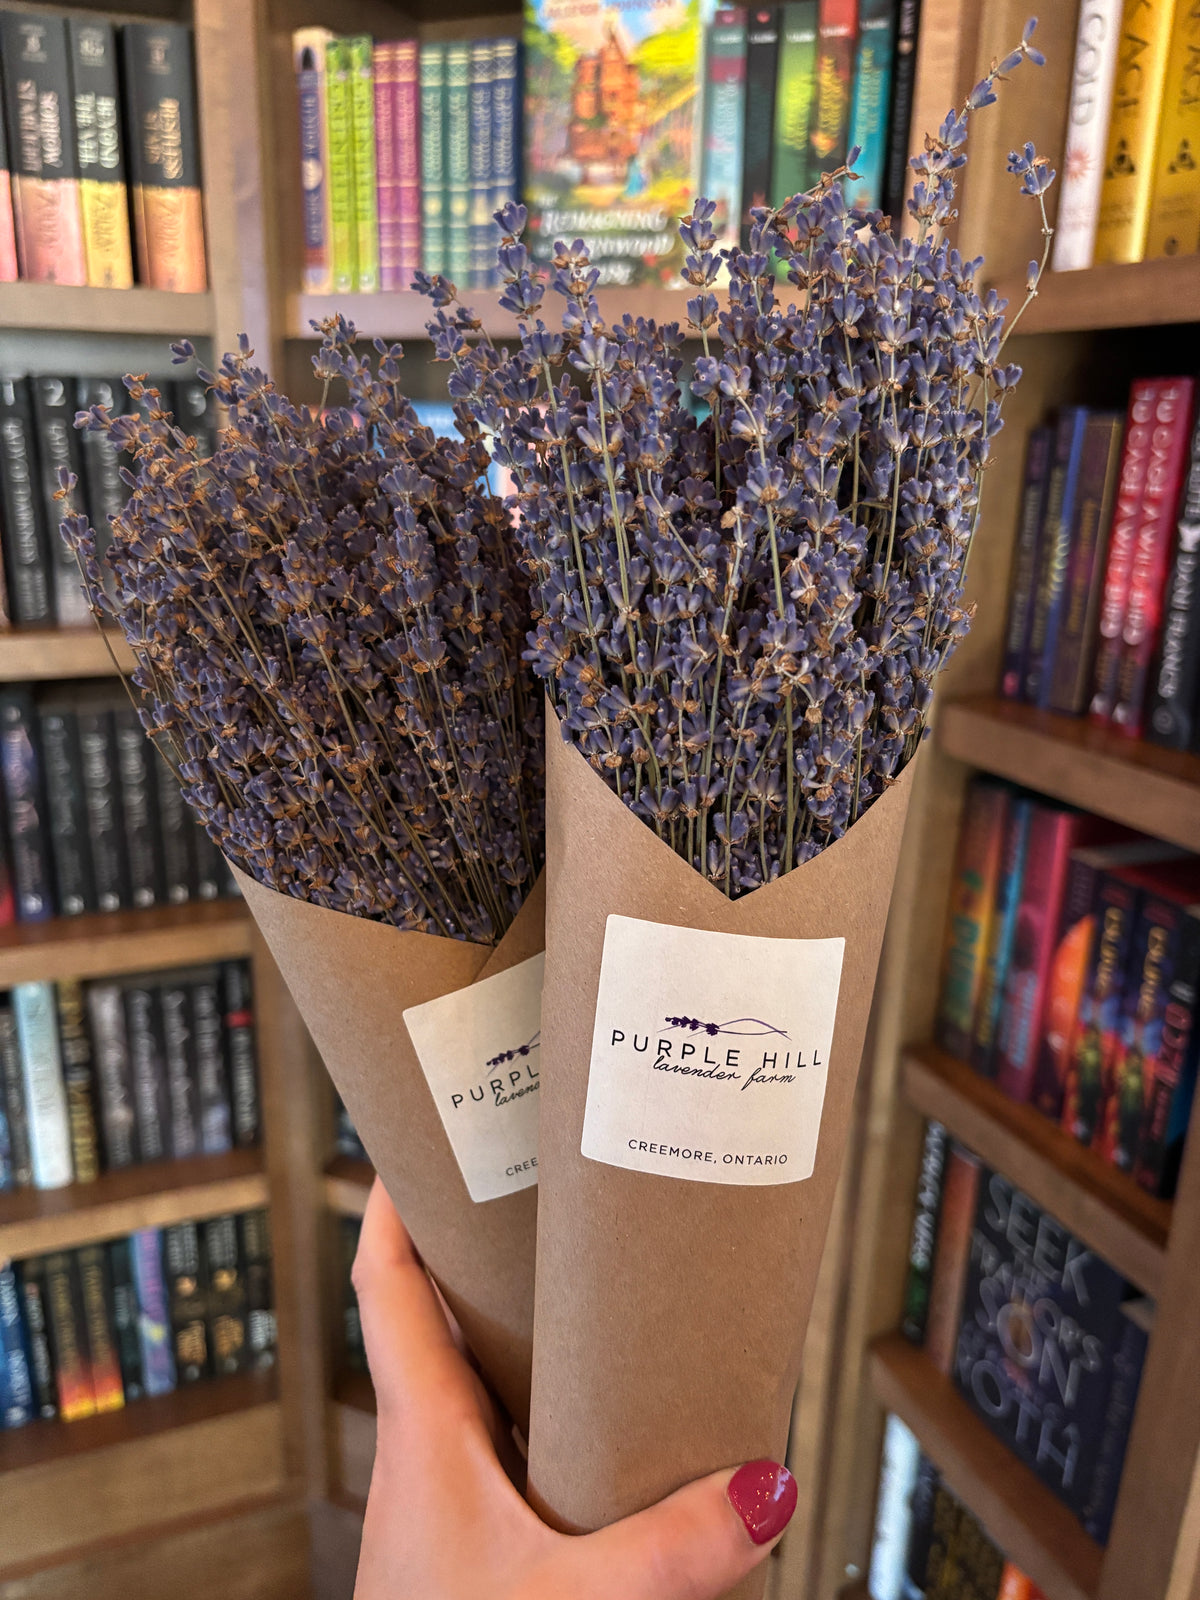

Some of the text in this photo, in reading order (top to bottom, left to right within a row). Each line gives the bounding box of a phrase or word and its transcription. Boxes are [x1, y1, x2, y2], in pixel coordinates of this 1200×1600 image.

[43, 378, 67, 407] 2
[611, 1029, 822, 1069] PURPLE HILL
[451, 1064, 540, 1109] PURPL
[652, 1055, 797, 1091] lavender farm
[495, 1081, 540, 1107] laven
[628, 1139, 788, 1166] CREEMORE, ONTARIO
[985, 1173, 1091, 1307] SEEK
